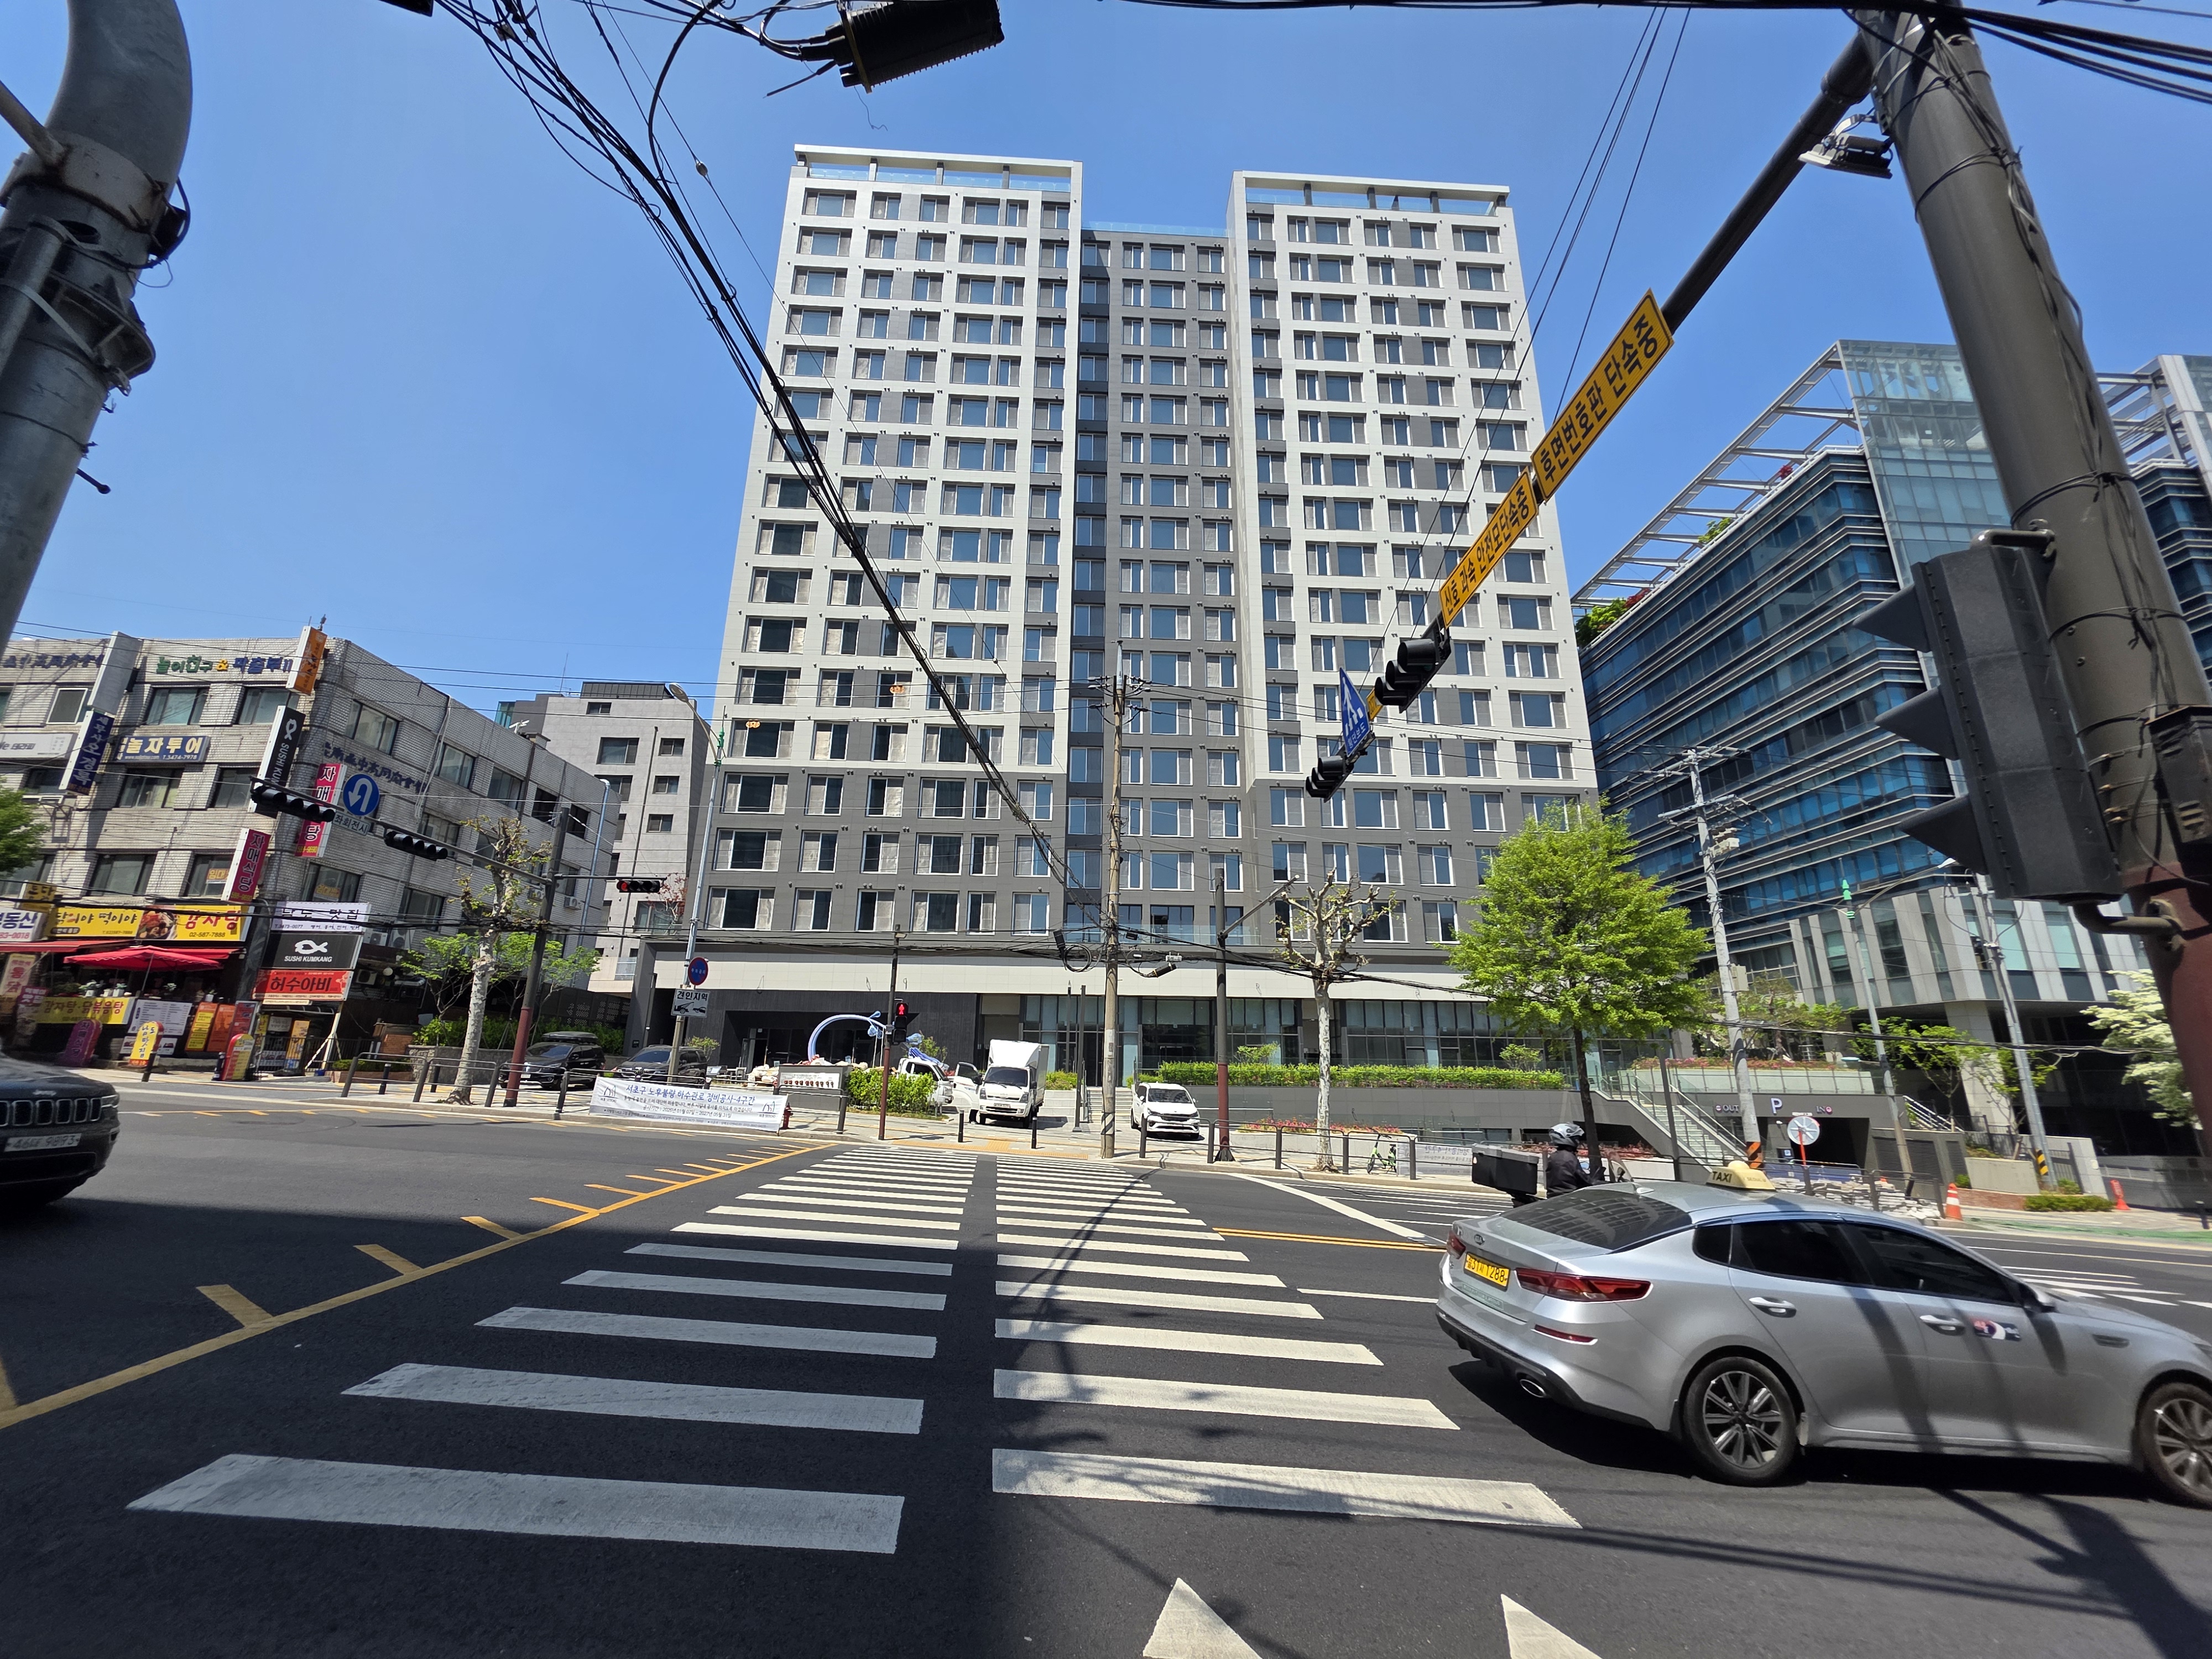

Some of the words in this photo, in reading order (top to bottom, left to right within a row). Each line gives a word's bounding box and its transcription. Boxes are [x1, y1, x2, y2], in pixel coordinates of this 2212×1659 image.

[1540, 379, 1608, 483] 후면번호판
[1603, 314, 1658, 399] 단속중
[1444, 579, 1460, 616] 신호
[1460, 557, 1477, 594] 과속
[1475, 484, 1530, 575] 안전모단속중
[156, 654, 213, 674] 놀이친구
[215, 659, 229, 671] &
[90, 716, 109, 742] 세무사
[1348, 722, 1366, 749] 횡단보도
[126, 737, 204, 754] 놀자투어
[277, 742, 289, 766] SUSHI
[305, 766, 335, 841] 자매당
[335, 814, 369, 834] 좌회전시
[238, 833, 265, 892] 자매식당
[0, 912, 38, 929] 동산
[270, 977, 332, 992] 허수아비
[677, 990, 708, 1001] 견인지역
[626, 1084, 646, 1095] 서초구
[648, 1087, 676, 1099] 노후불량
[677, 1089, 705, 1100] 하수관로
[707, 1093, 755, 1106] 정비공사-4구간
[1771, 1097, 1783, 1115] P
[1713, 1171, 1732, 1183] TAXI
[1485, 1264, 1505, 1283] 1288
